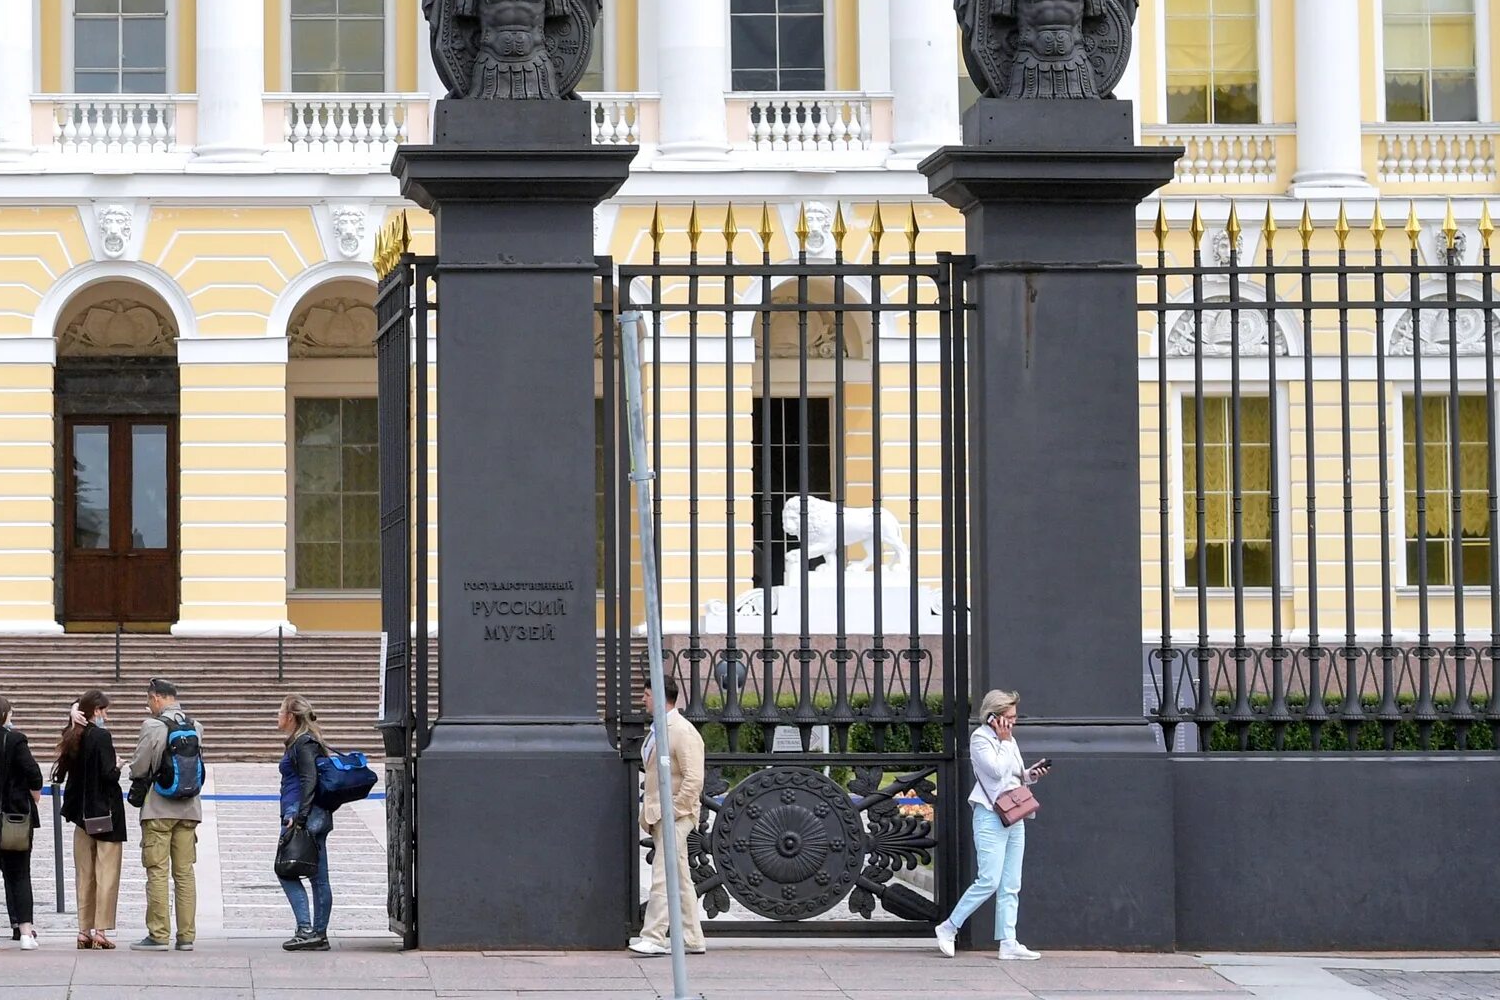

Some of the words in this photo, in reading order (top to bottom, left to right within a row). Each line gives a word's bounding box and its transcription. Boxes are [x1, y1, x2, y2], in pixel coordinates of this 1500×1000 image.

[464, 581, 574, 591] ГОСУДАРСТВЕННЫЙ
[472, 599, 567, 617] РУССКИЙ
[484, 623, 556, 641] МУЗЕЙ
